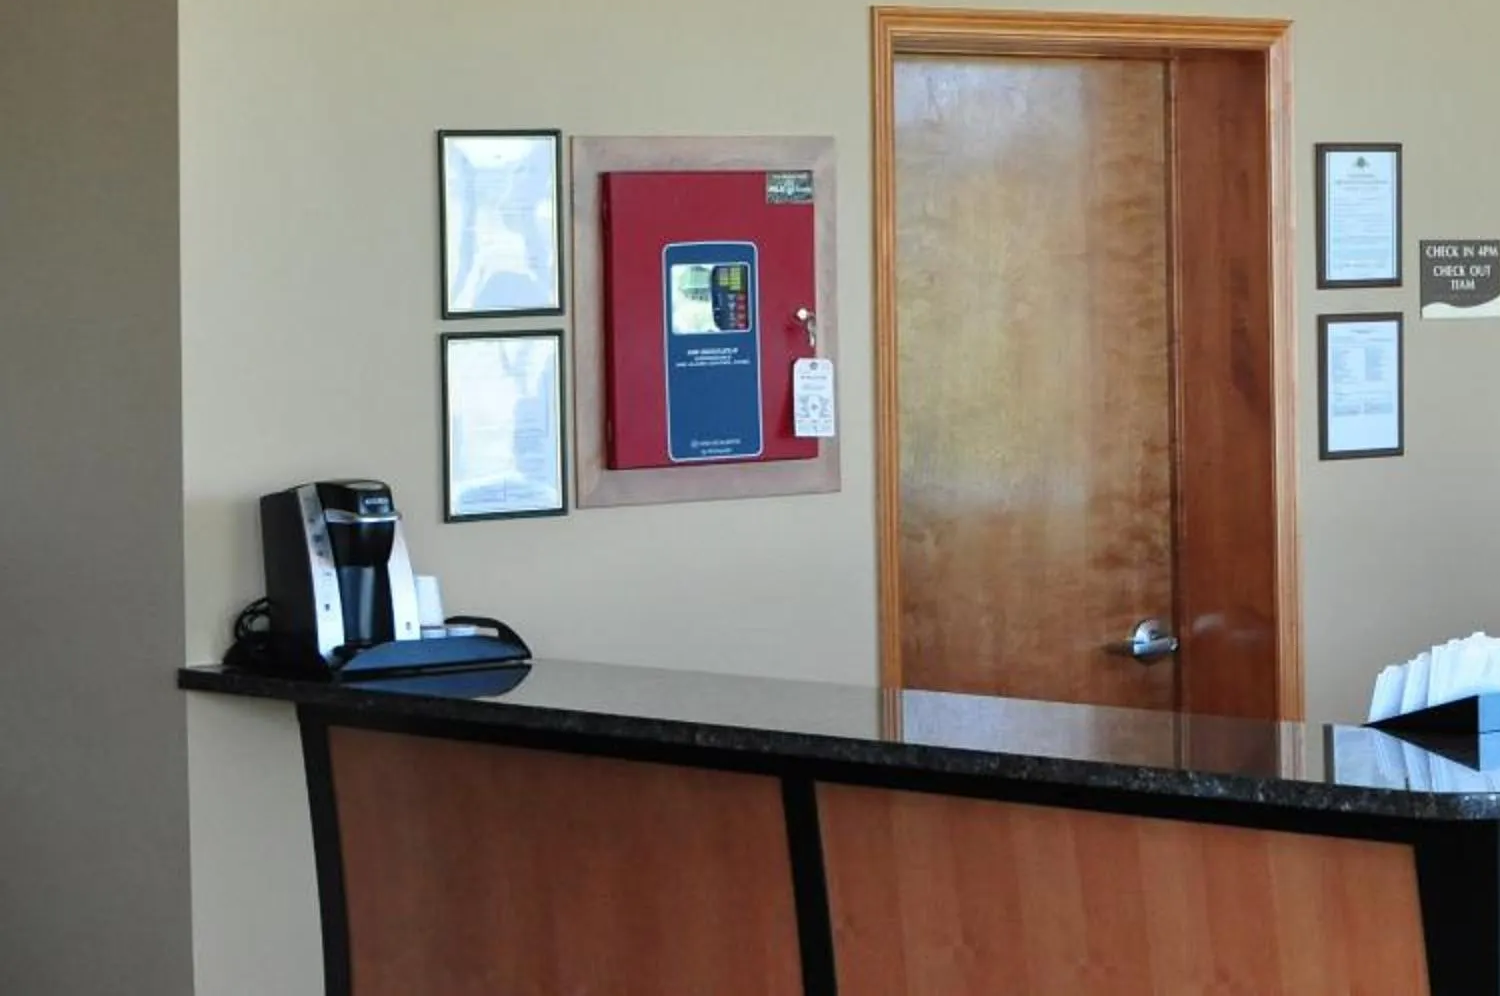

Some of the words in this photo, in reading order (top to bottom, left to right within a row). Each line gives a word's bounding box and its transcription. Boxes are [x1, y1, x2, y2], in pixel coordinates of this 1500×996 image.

[1425, 245, 1459, 258] CHECK
[1463, 245, 1474, 257] IN
[1433, 265, 1466, 277] CHECK
[1469, 265, 1491, 277] OUT
